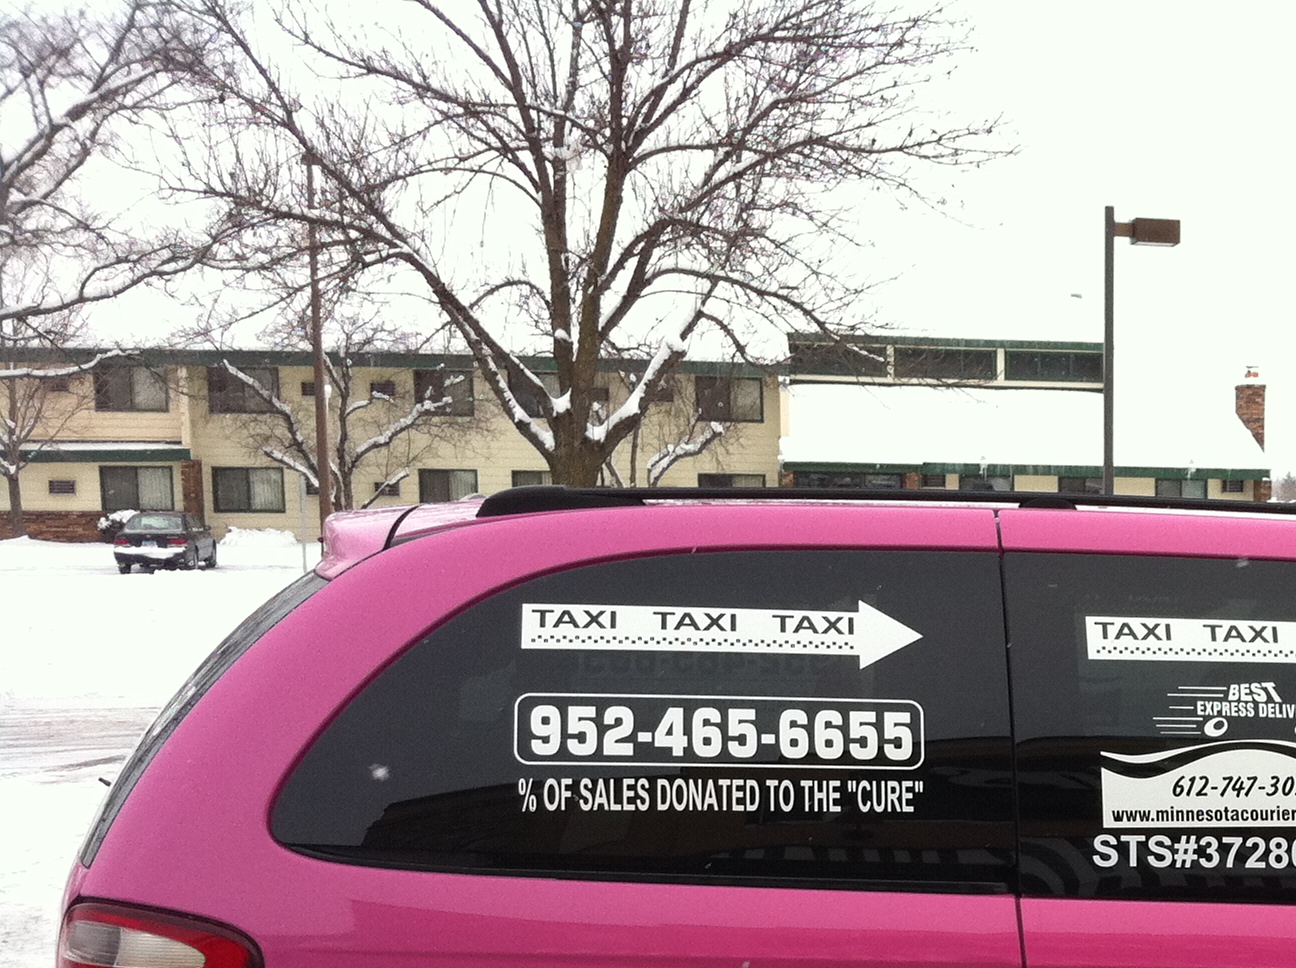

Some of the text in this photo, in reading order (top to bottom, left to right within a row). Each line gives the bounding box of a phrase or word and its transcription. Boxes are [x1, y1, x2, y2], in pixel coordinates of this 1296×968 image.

[531, 609, 855, 635] TAXI TAXI TAXI
[1095, 621, 1172, 642] TAXI
[1203, 623, 1278, 644] TAXI
[1228, 681, 1282, 703] BEST
[1196, 700, 1255, 717] EXPRESS
[529, 704, 914, 761] 952-465-6655
[518, 778, 924, 813] % OF SALES DONATED TO THE "CURE"
